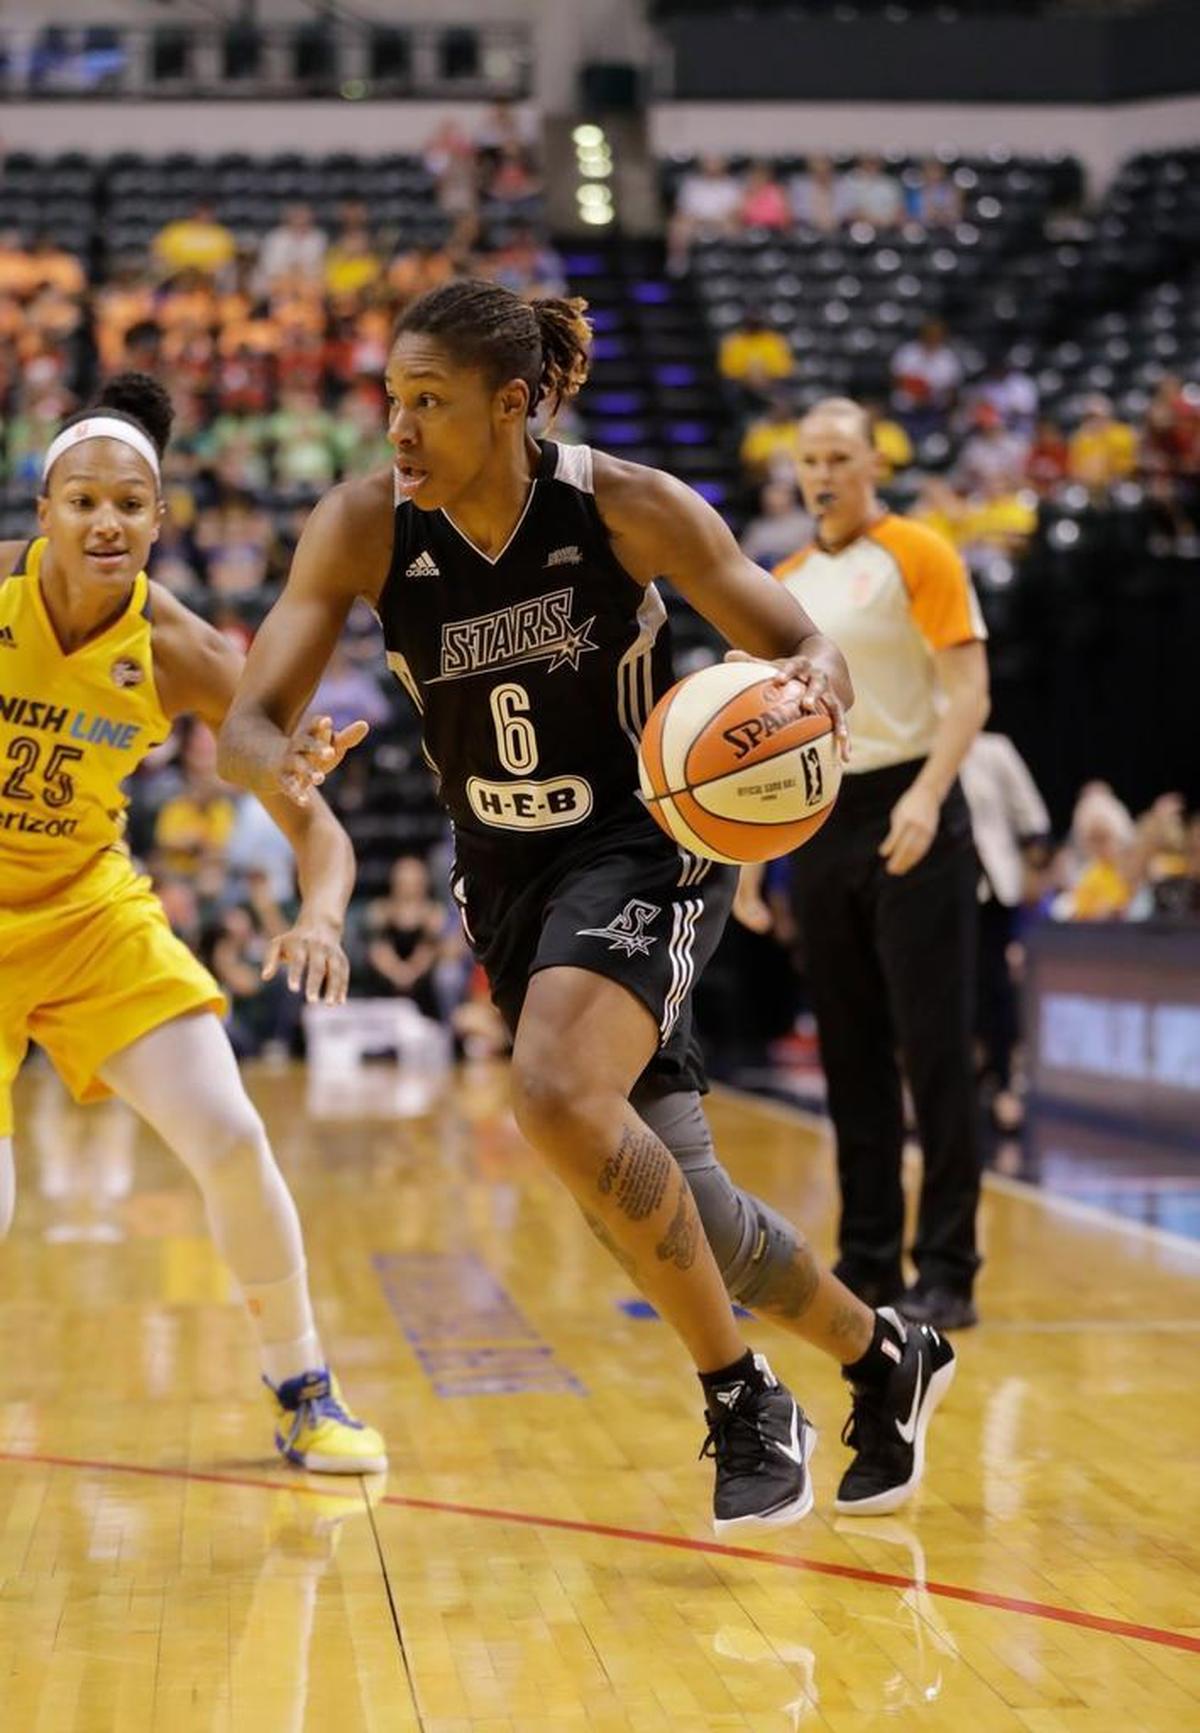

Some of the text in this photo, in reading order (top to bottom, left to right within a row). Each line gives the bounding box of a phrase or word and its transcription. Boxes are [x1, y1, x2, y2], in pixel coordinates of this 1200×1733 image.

[405, 566, 440, 578] adidas
[441, 587, 574, 677] STARS
[70, 710, 141, 749] LINE
[490, 683, 538, 775] 6
[3, 736, 84, 809] 25
[478, 787, 577, 819] H-E-B
